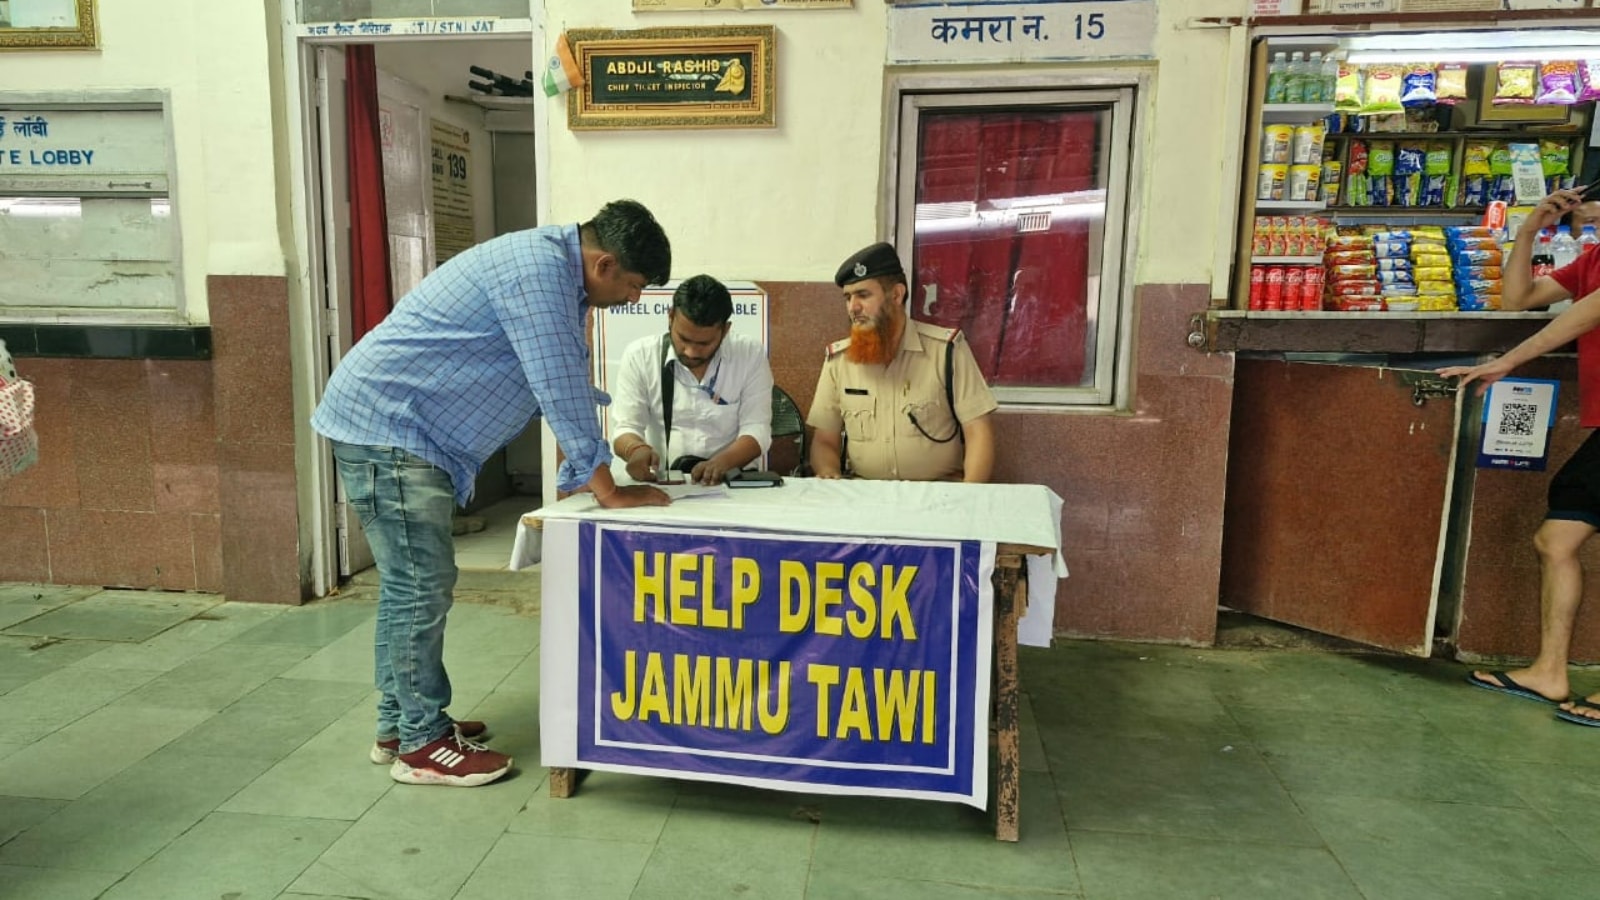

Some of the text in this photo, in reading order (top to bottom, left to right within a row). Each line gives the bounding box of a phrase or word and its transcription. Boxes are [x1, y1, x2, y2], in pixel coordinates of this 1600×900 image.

[931, 16, 1016, 43] कमरा
[1075, 13, 1105, 40] 15
[662, 59, 721, 74] RASHID
[607, 83, 630, 92] CHIEF
[13, 116, 48, 137] लॉबी
[30, 150, 94, 165] LOBBY
[447, 152, 467, 180] 139
[610, 304, 651, 315] WHEEL
[654, 303, 670, 315] CH
[633, 551, 920, 641] HELP DESK
[610, 650, 937, 745] JAMMU TAWI
